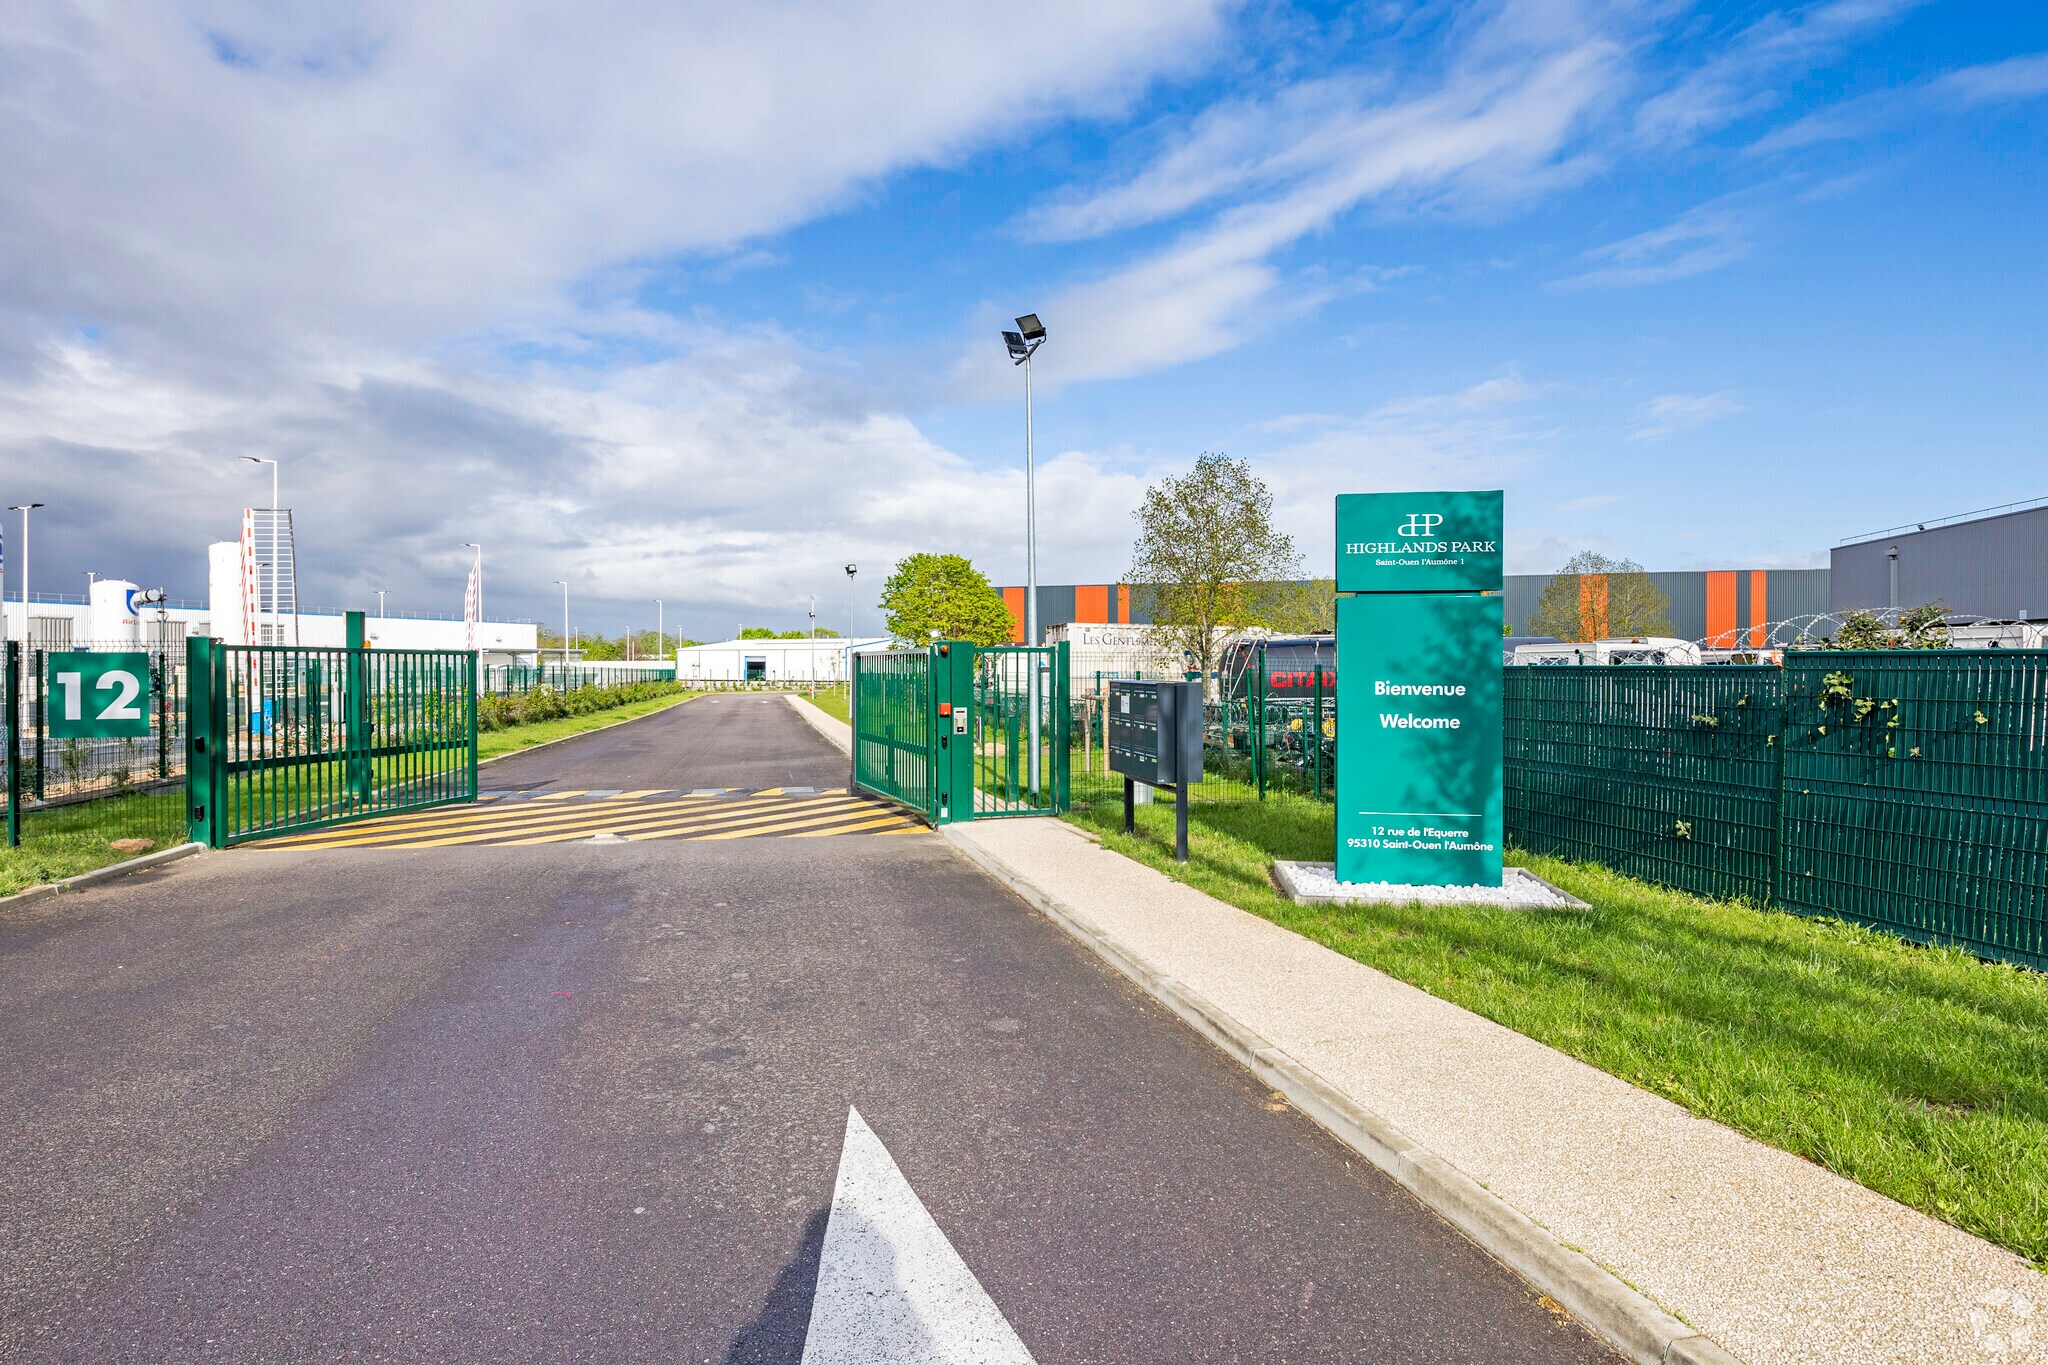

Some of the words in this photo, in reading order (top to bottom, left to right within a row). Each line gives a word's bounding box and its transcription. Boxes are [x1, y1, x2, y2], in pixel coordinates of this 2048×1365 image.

[1345, 541, 1448, 555] HIGHLANDS
[1450, 541, 1496, 553] PARK
[1375, 558, 1420, 566] Saint-Ouen
[1421, 558, 1458, 566] l'Aumône
[57, 670, 141, 721] 12
[1374, 680, 1466, 697] Bienvenue
[1379, 712, 1461, 729] Welcome
[1371, 826, 1385, 836] 12
[1387, 828, 1405, 837] rue
[1407, 827, 1421, 837] de
[1423, 827, 1469, 840] l'Equerre
[1347, 837, 1381, 849] 95310
[1382, 839, 1442, 850] Saint-Ouen
[1444, 840, 1494, 852] l'Aumône
